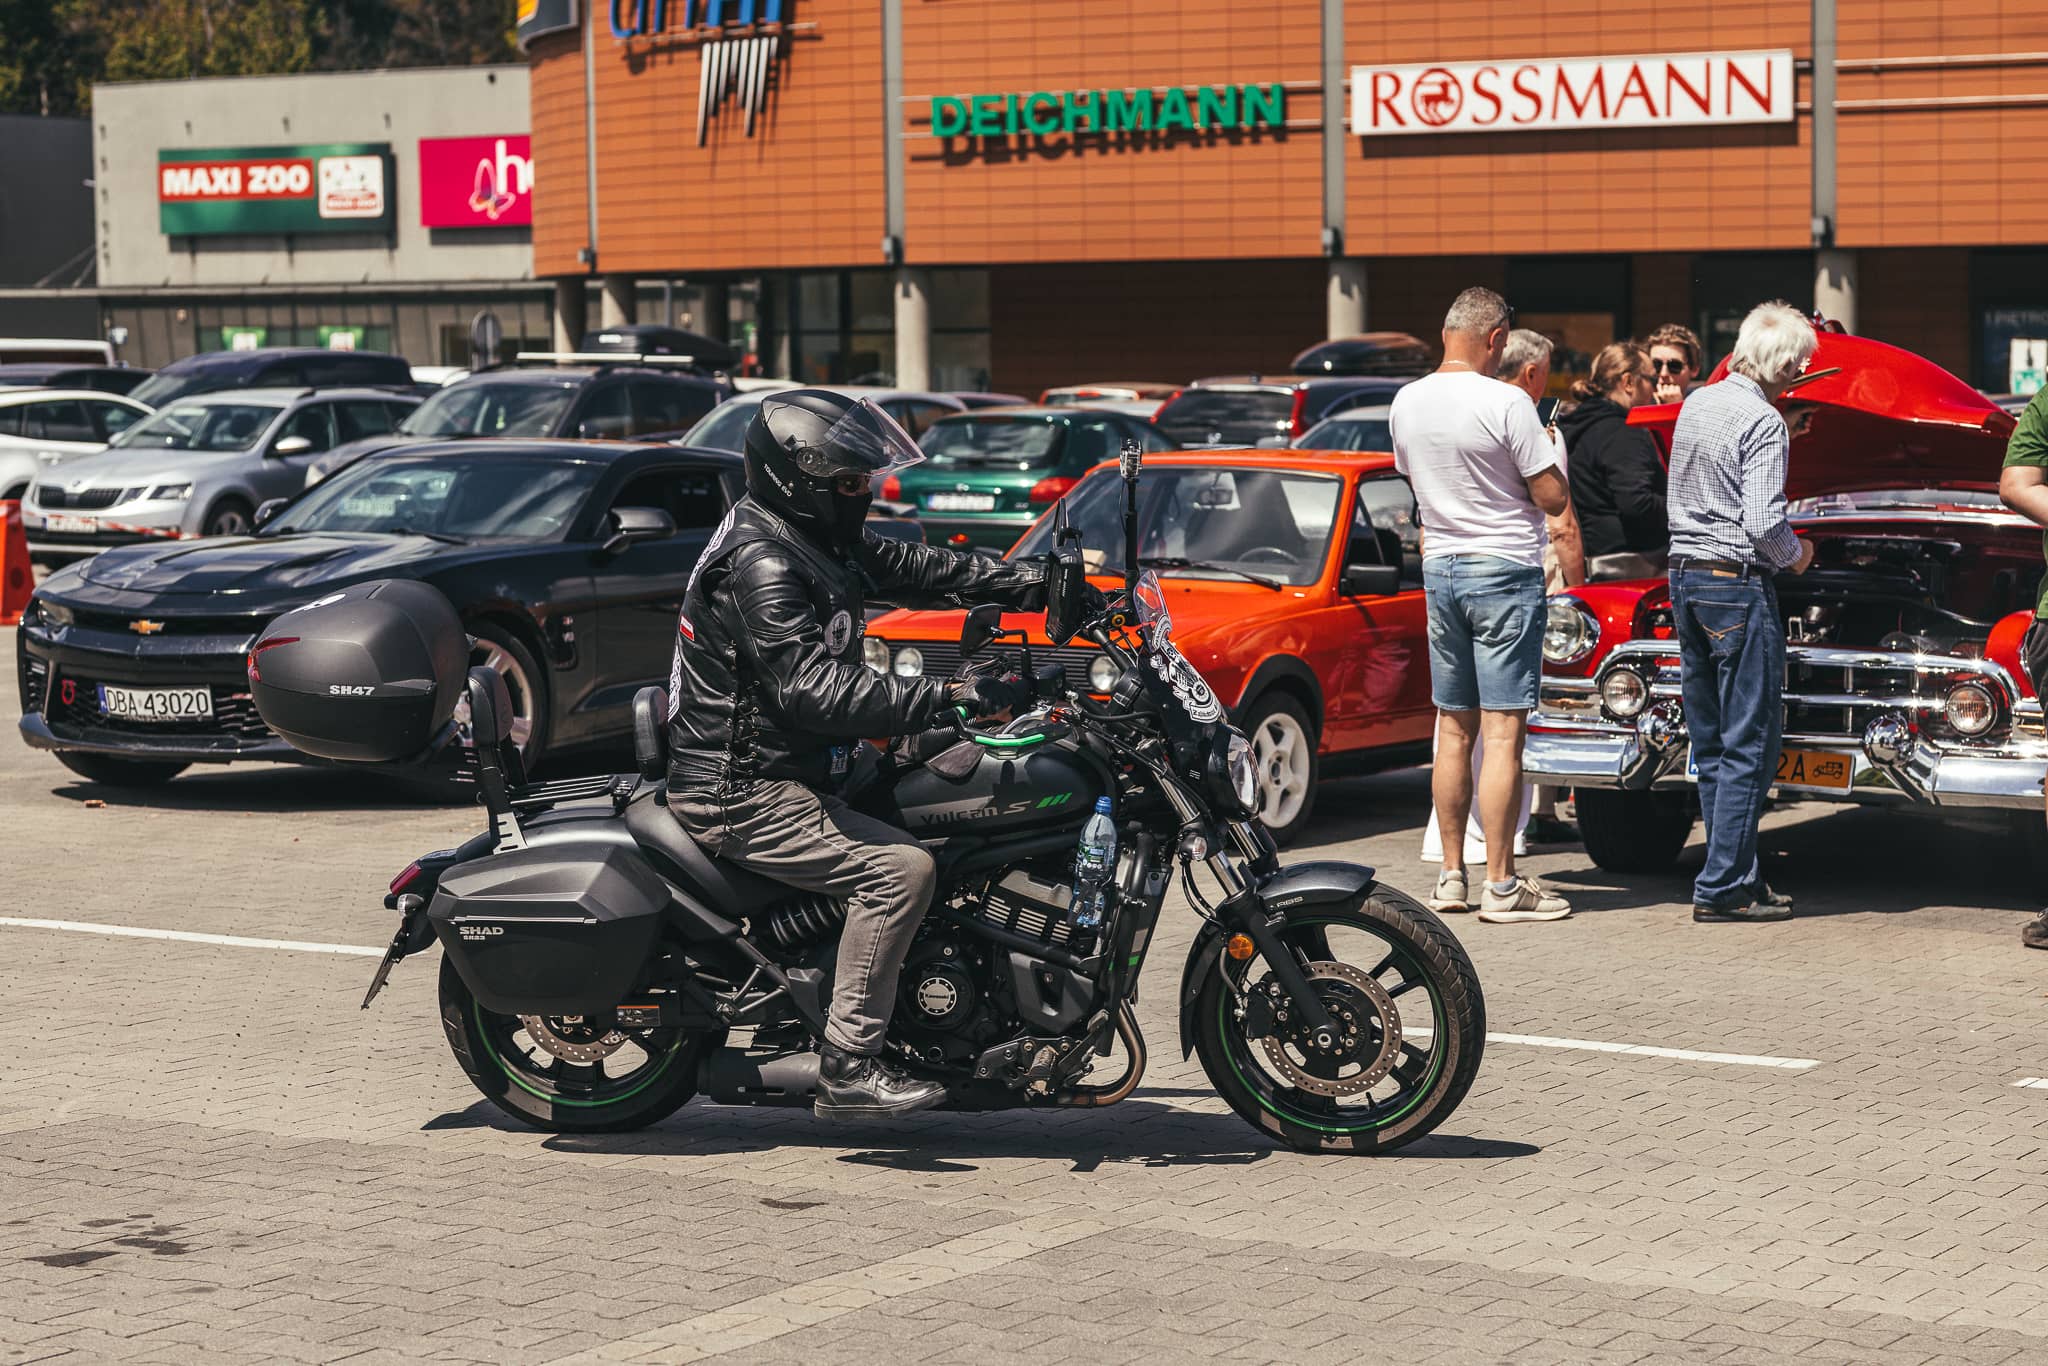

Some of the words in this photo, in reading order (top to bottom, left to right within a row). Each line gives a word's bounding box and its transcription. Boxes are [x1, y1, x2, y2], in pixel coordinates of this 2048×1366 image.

[1371, 58, 1772, 127] ROSSMANN
[931, 84, 1284, 136] DEICHMANN
[162, 166, 241, 196] MAXI
[247, 164, 310, 193] ZOO
[106, 690, 138, 715] DBA
[144, 692, 209, 715] 43020
[329, 685, 375, 696] SH47
[1003, 800, 1032, 814] S
[459, 926, 505, 935] SHAD
